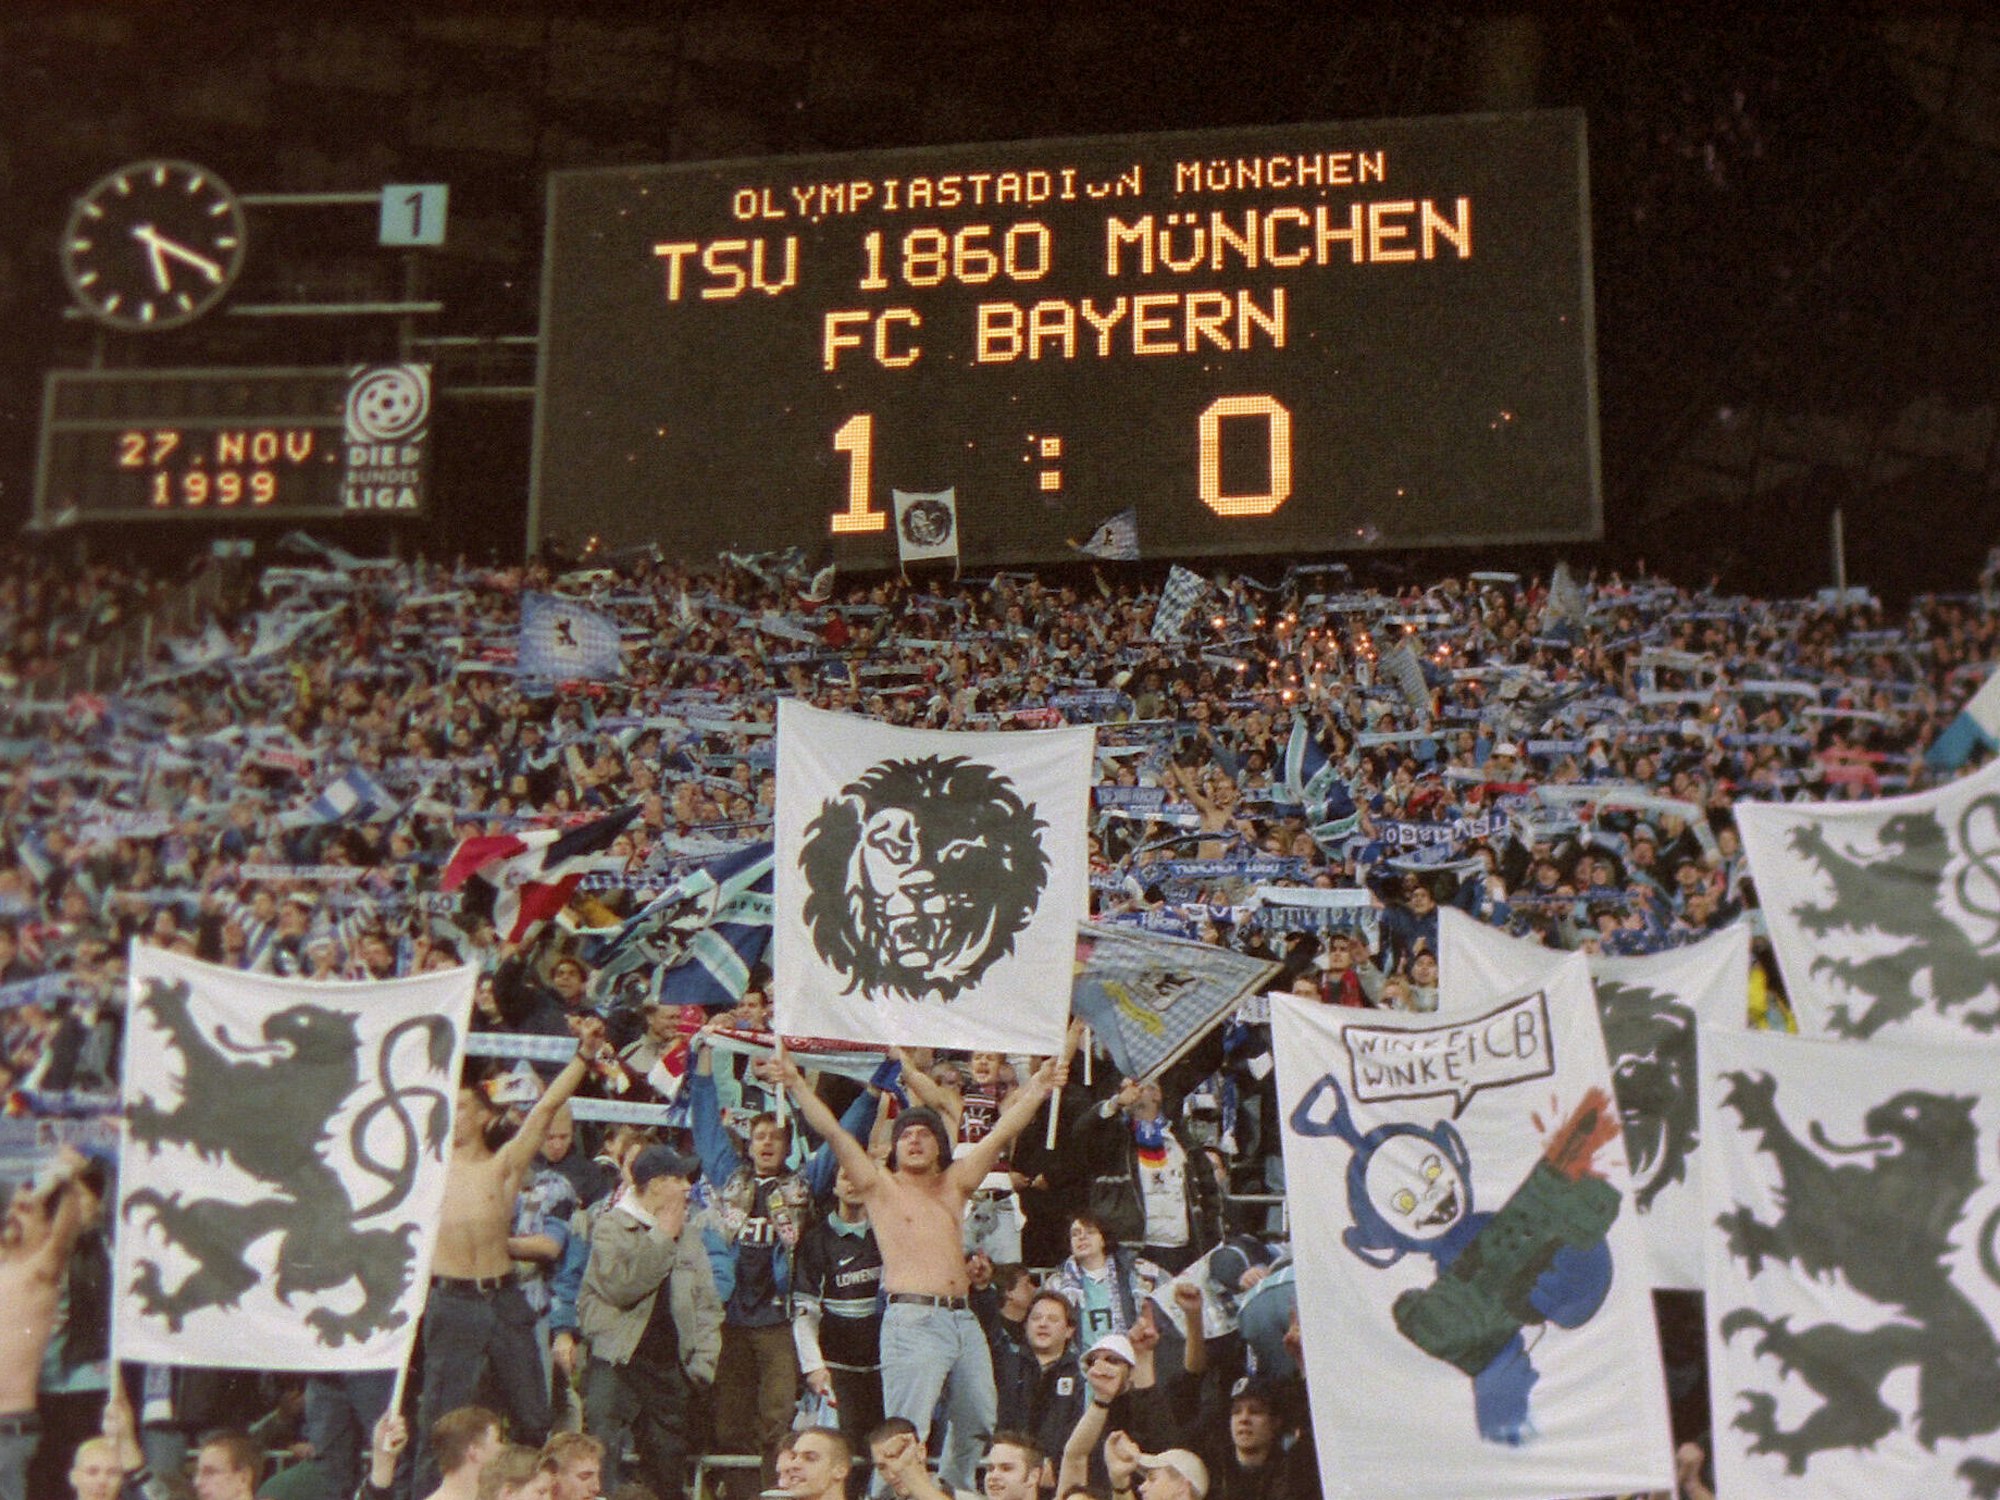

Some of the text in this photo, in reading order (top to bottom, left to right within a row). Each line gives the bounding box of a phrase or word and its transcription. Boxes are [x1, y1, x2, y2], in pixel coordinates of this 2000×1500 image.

[1176, 150, 1386, 195] MÜNCHEN
[404, 190, 425, 237] 1
[653, 197, 1473, 301] TSV 1860 MÜNCHEN
[823, 287, 1287, 371] FC BAYERN
[348, 446, 396, 466] DIE
[830, 413, 887, 534] 1
[1198, 393, 1293, 517] 0
[152, 471, 278, 508] 1999
[345, 487, 418, 509] LIGA
